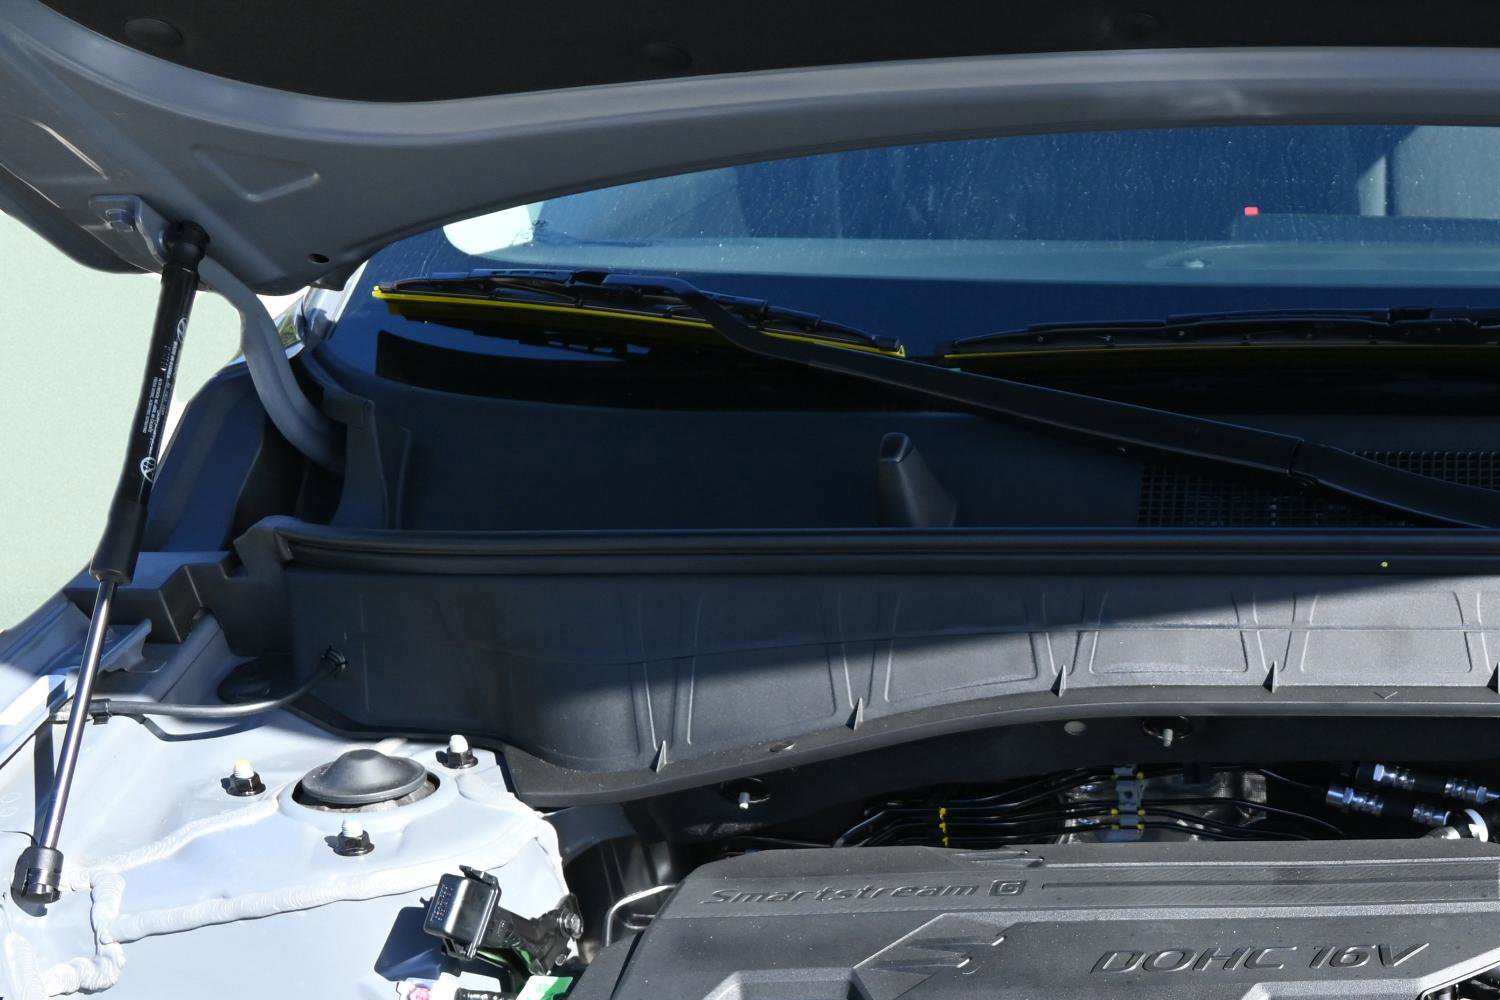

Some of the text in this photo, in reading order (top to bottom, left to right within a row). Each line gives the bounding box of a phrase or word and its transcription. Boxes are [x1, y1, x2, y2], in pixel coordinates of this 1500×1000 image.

[699, 886, 979, 904] Smartstream
[1090, 942, 1430, 974] DOHC 16V
